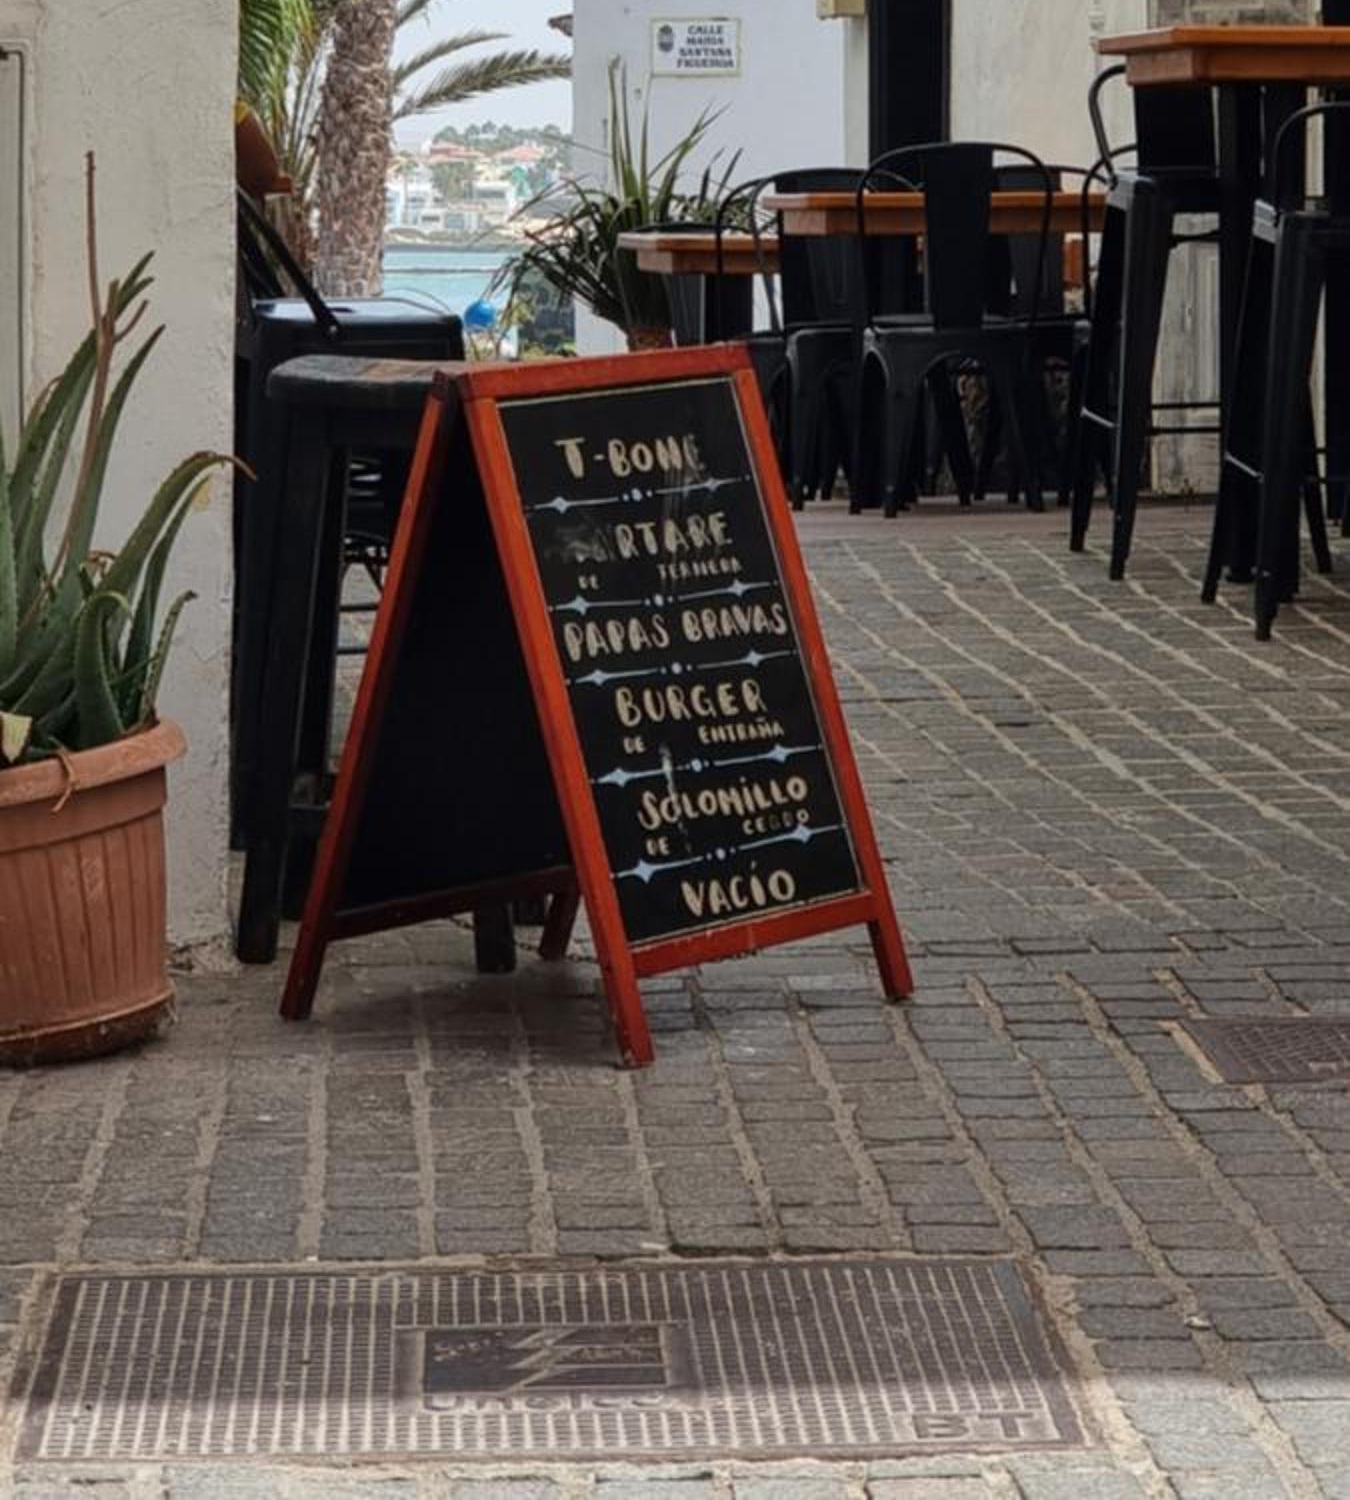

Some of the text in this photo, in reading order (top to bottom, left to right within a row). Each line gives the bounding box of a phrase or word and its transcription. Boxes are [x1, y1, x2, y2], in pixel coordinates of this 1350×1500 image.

[564, 603, 787, 662] PAPAS BRAVAS
[615, 679, 768, 727] BURGER
[623, 717, 785, 754] DE ENTRAÑA
[639, 776, 808, 830] SOLOMILLO
[646, 836, 671, 856] DE
[681, 861, 796, 917] VACÍO
[911, 1411, 1034, 1440] BT
